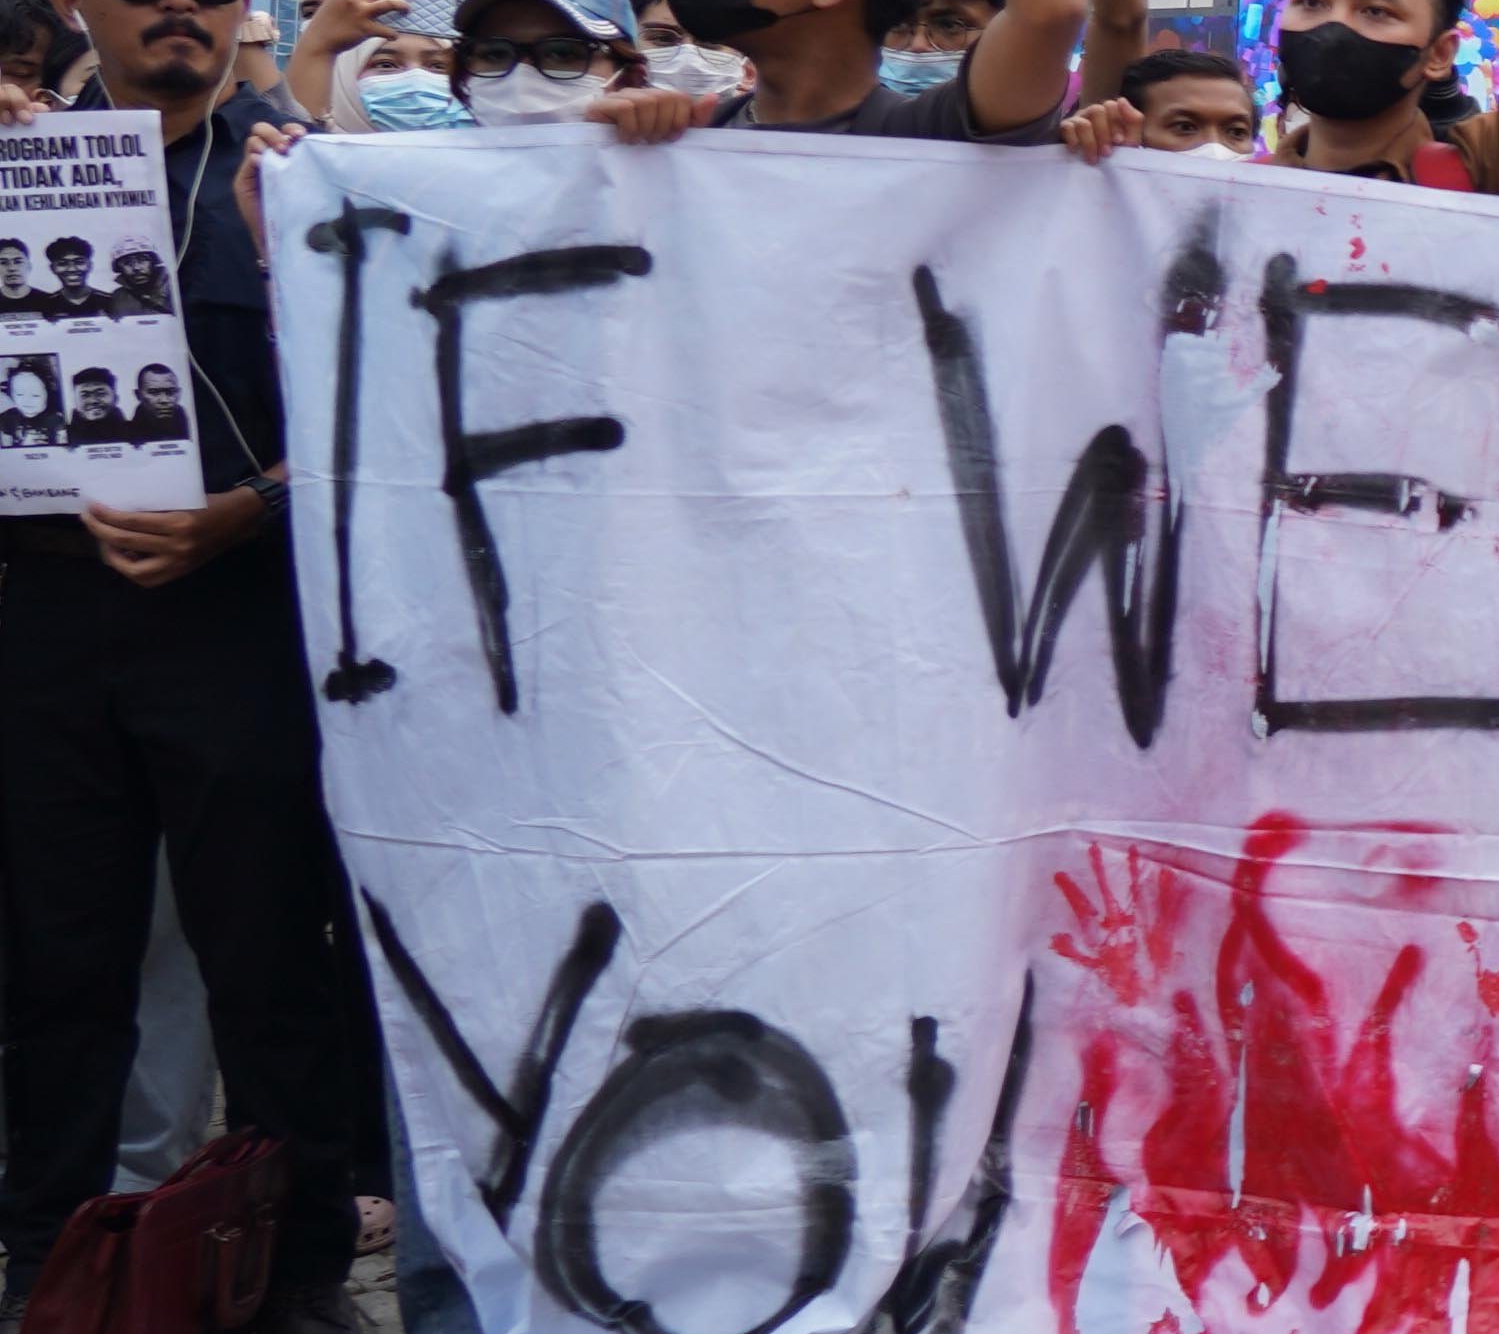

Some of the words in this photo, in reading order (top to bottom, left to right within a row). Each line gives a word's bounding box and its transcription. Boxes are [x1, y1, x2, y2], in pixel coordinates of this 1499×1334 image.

[83, 134, 147, 158] TOLOL
[1, 164, 65, 190] TIDAK
[72, 163, 123, 188] ADA,
[303, 195, 655, 717] IF
